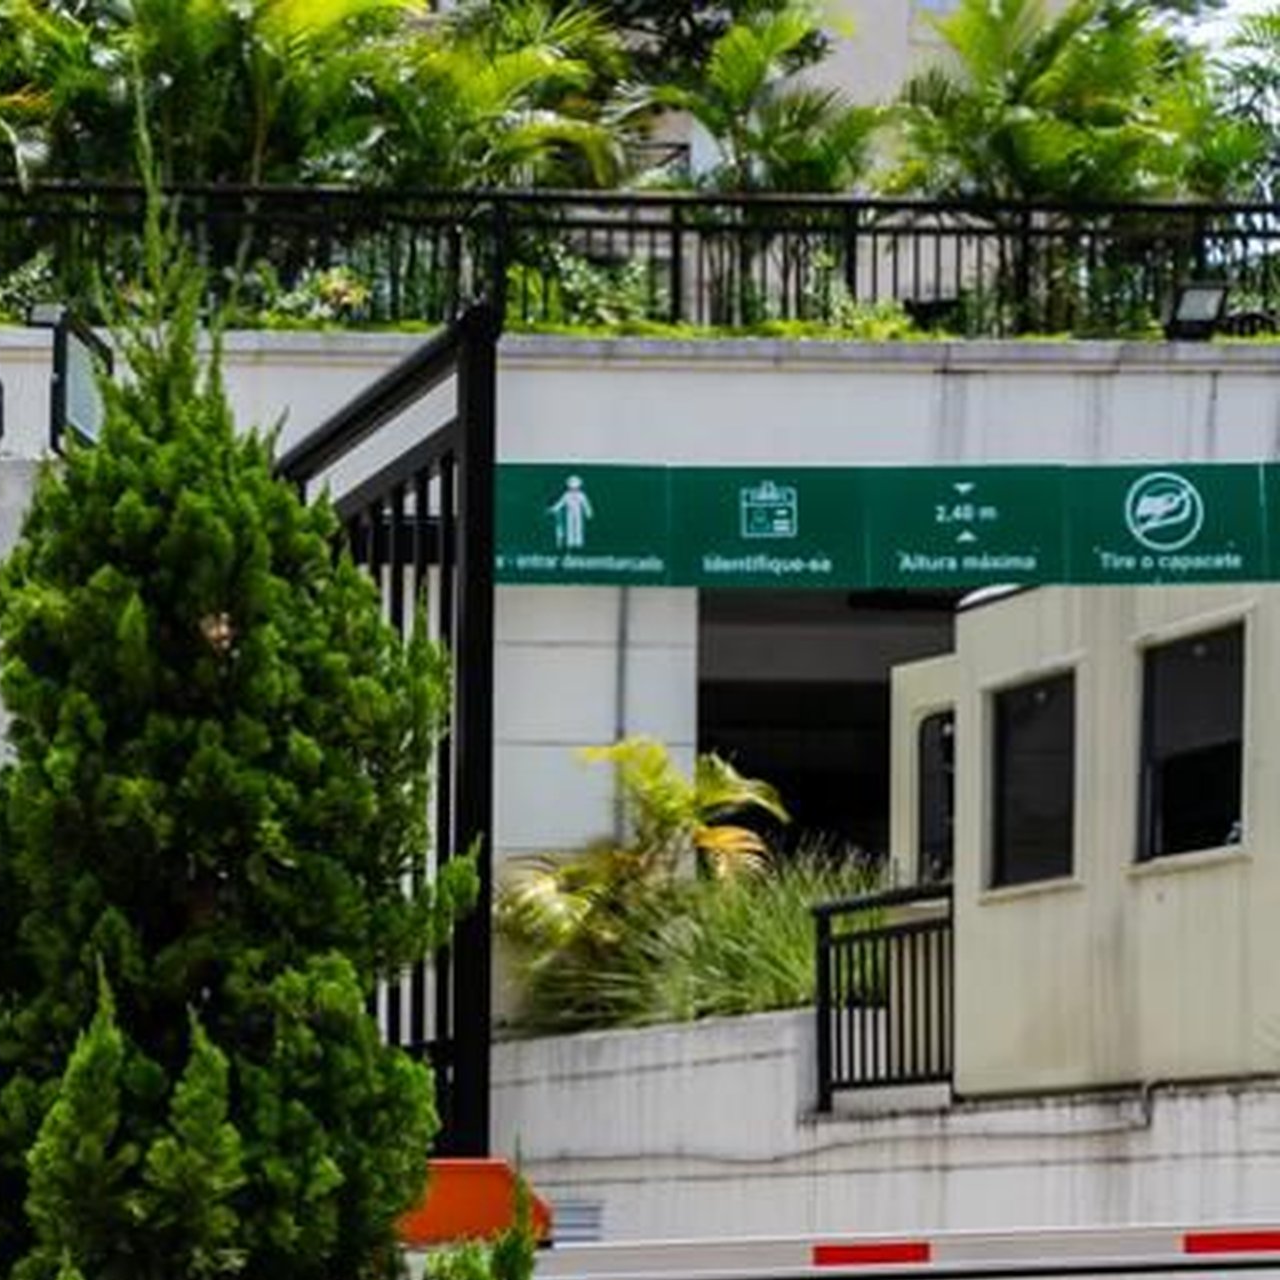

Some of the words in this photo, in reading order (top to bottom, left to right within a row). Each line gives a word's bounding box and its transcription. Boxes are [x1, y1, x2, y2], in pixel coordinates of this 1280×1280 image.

[701, 554, 834, 576] Identifique-se
[899, 552, 958, 572] Altura
[1100, 551, 1138, 570] Tire
[1141, 557, 1155, 570] o
[1159, 552, 1243, 573] capacete
